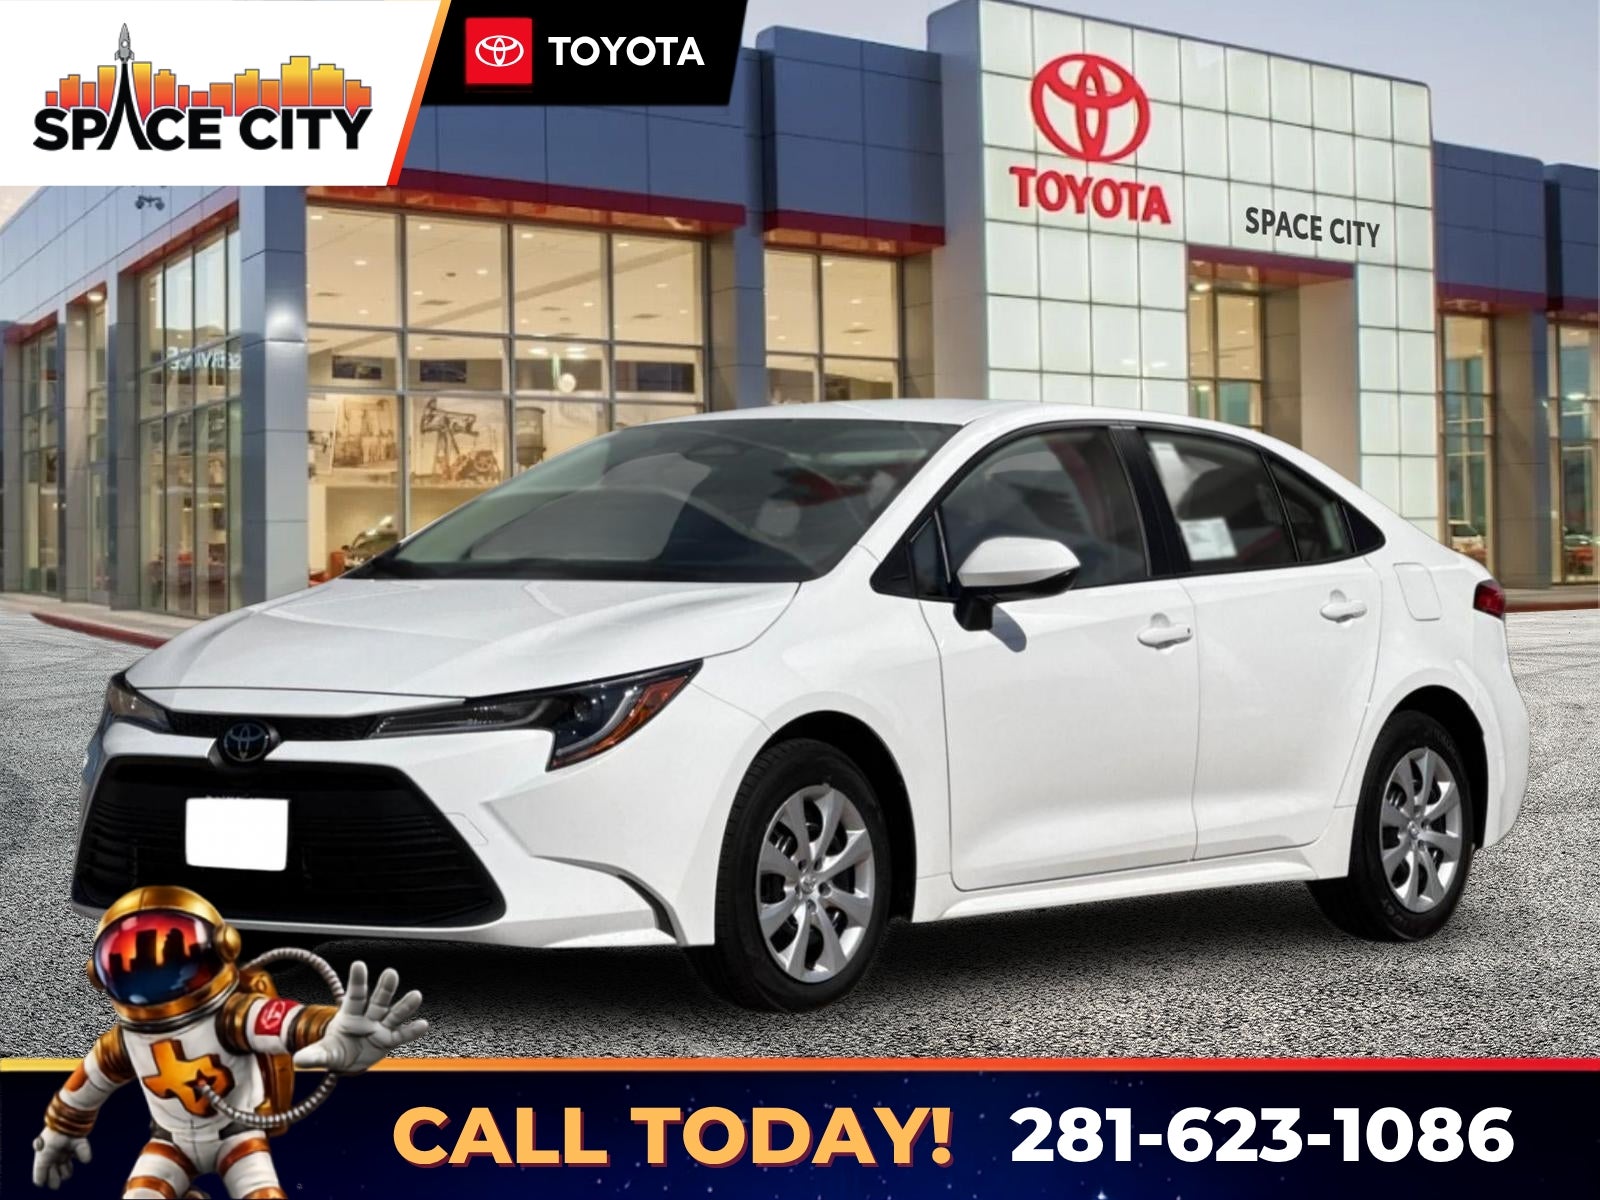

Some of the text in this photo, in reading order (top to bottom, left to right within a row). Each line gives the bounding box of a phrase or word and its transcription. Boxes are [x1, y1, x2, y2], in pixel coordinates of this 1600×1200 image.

[1009, 167, 1171, 224] TOYOTA
[1245, 207, 1381, 249] SPACE CITY
